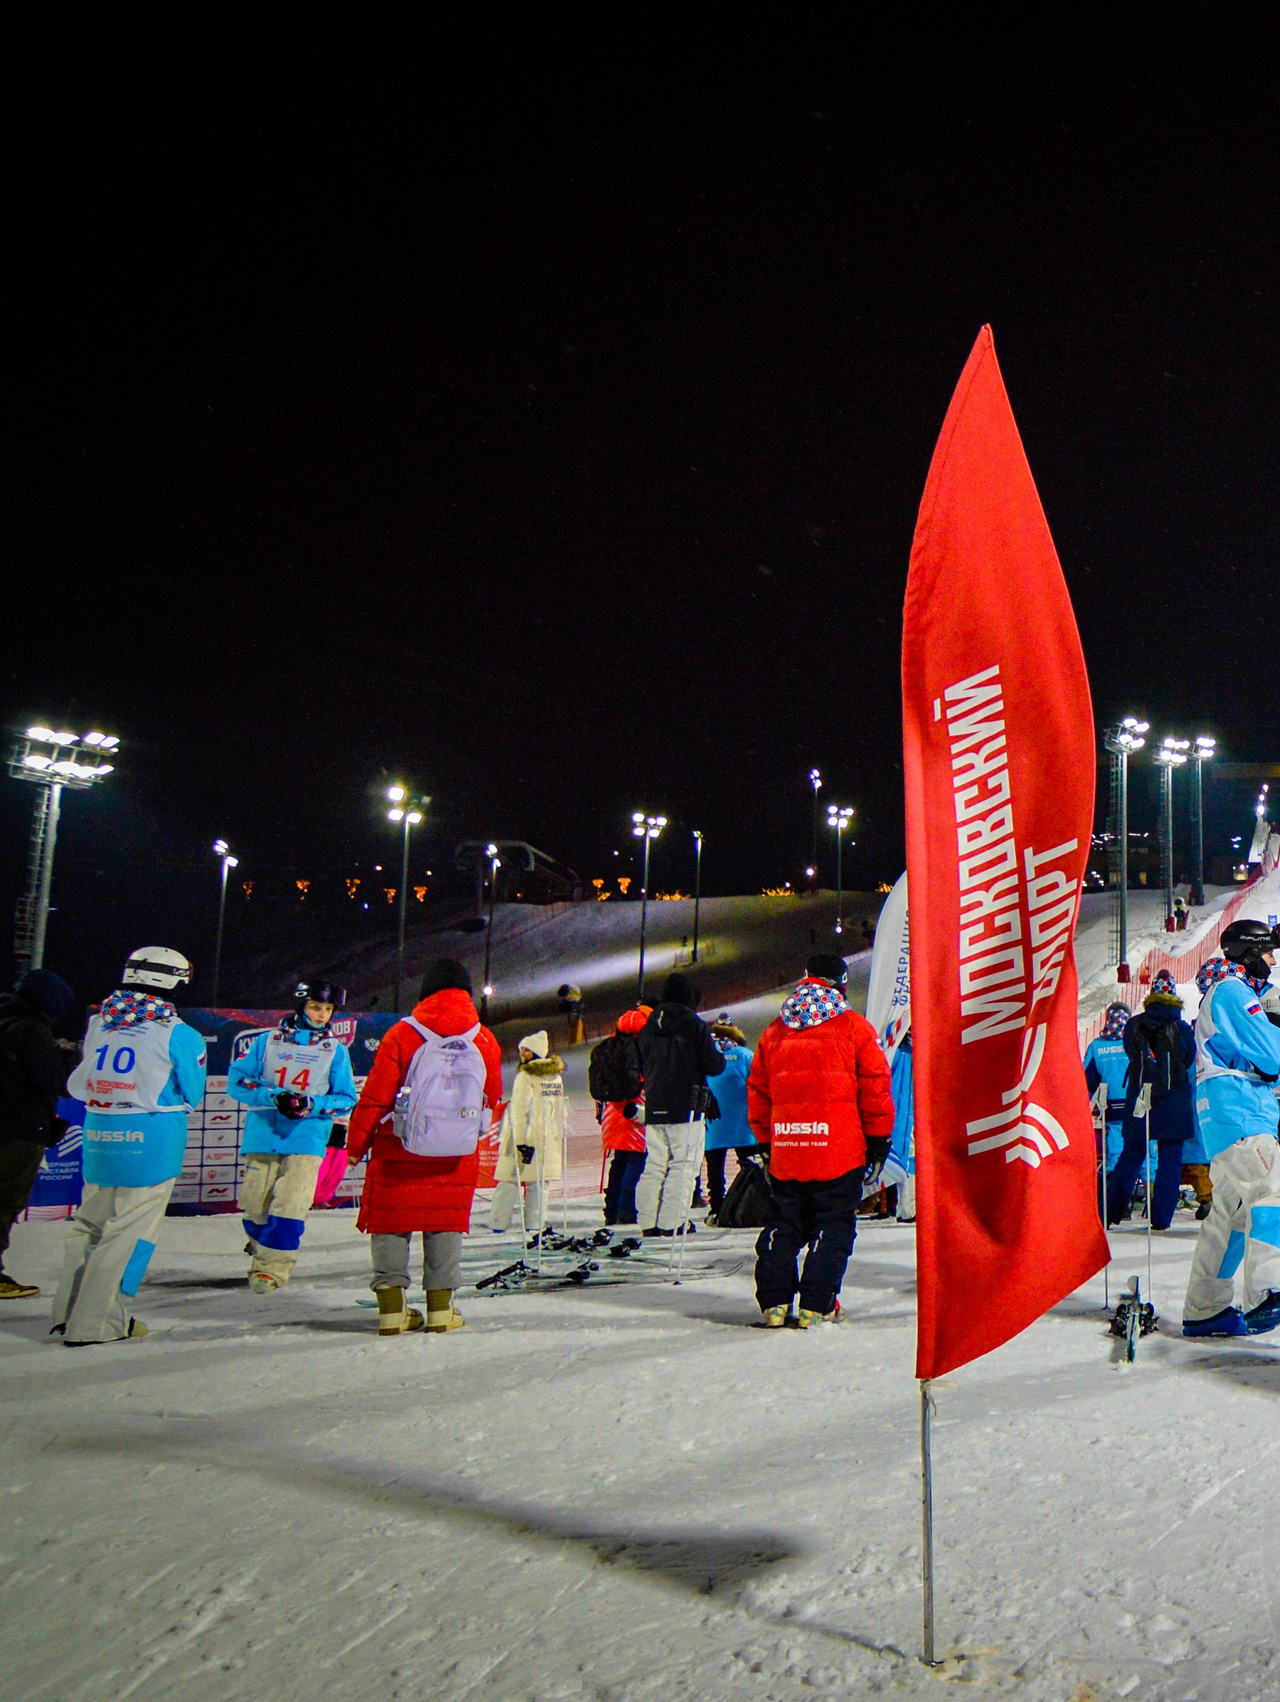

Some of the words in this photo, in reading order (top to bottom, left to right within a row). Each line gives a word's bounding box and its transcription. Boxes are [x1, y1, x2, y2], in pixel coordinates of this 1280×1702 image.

[934, 664, 1027, 1045] МОСКОВСКИЙ
[95, 1044, 136, 1074] 10
[274, 1066, 310, 1091] 14
[773, 1121, 829, 1136] RUSSIA
